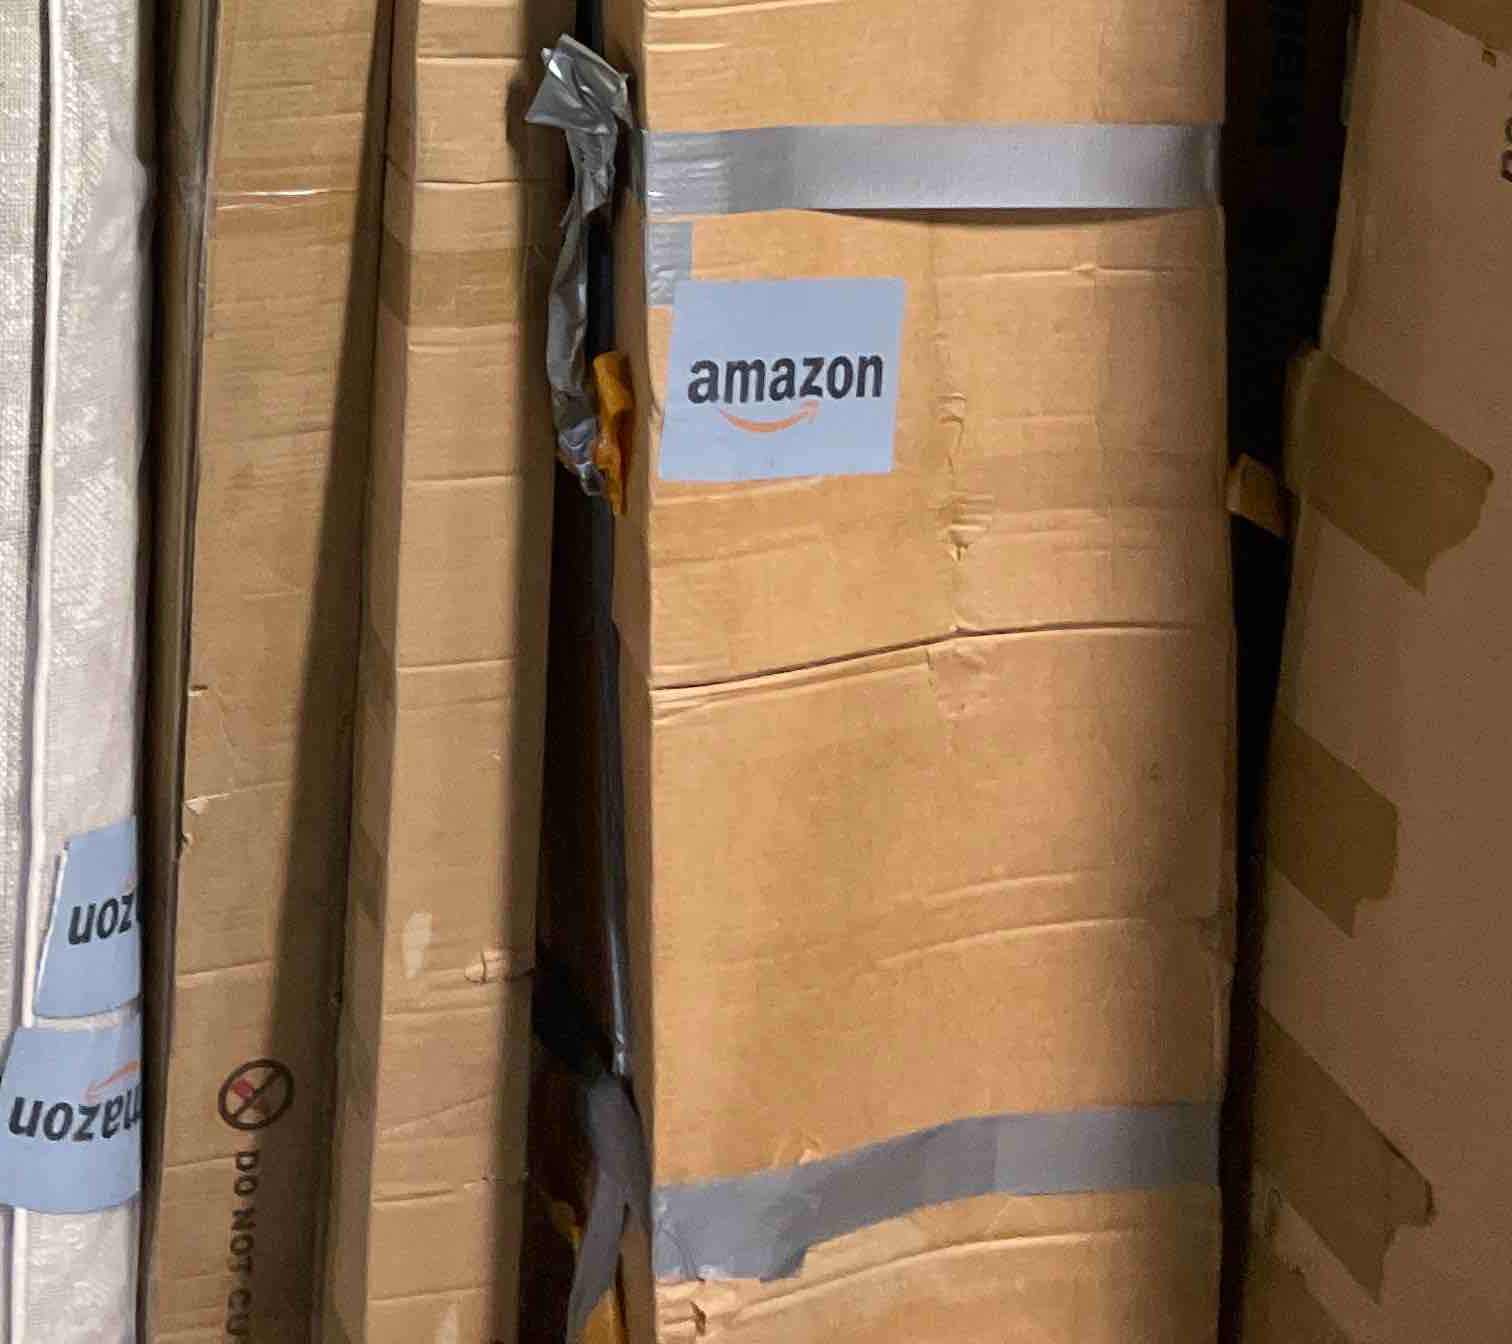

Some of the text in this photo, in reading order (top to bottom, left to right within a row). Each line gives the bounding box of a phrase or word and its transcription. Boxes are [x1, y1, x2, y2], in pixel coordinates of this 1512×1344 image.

[687, 353, 884, 406] amazon
[67, 893, 140, 946] zon
[8, 1082, 141, 1142] mazon
[225, 1151, 259, 1336] DO NOT CU
